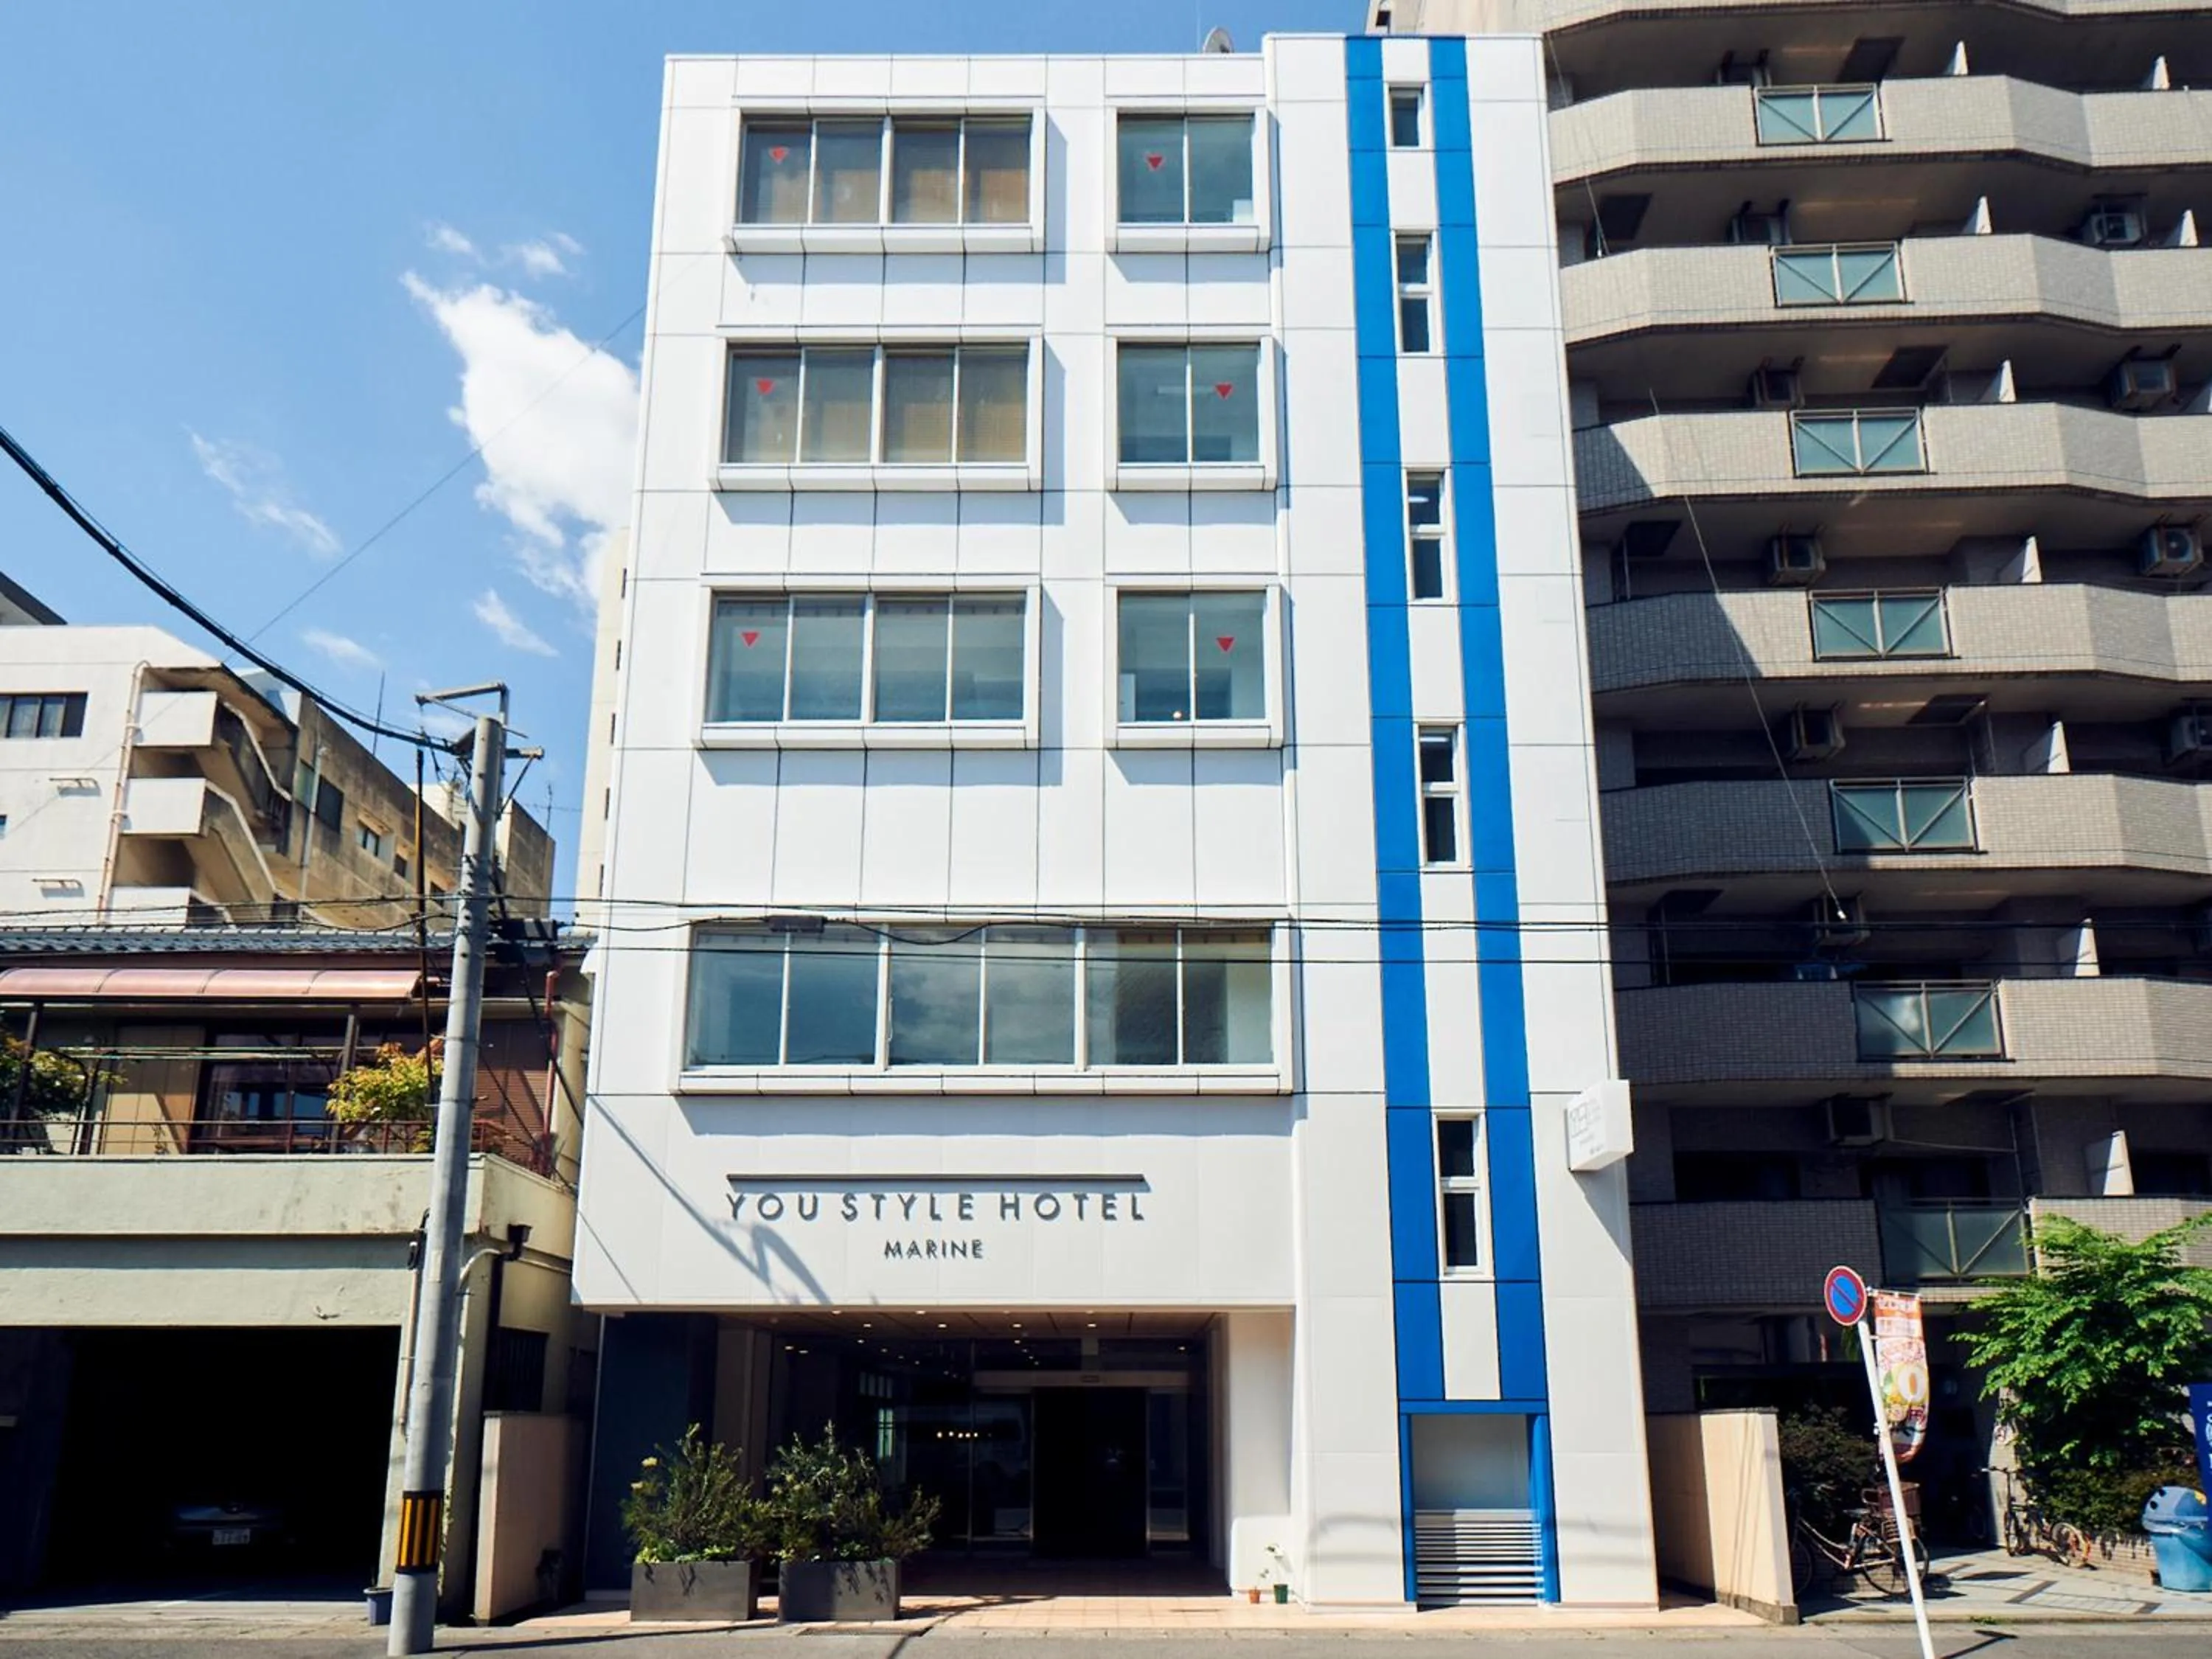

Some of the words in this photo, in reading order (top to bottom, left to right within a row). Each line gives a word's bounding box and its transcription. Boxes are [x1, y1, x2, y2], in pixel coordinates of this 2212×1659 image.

[726, 1192, 818, 1222] YOU
[841, 1192, 974, 1222] STYLE
[1000, 1192, 1144, 1221] HOTEL
[884, 1239, 983, 1259] MARINE
